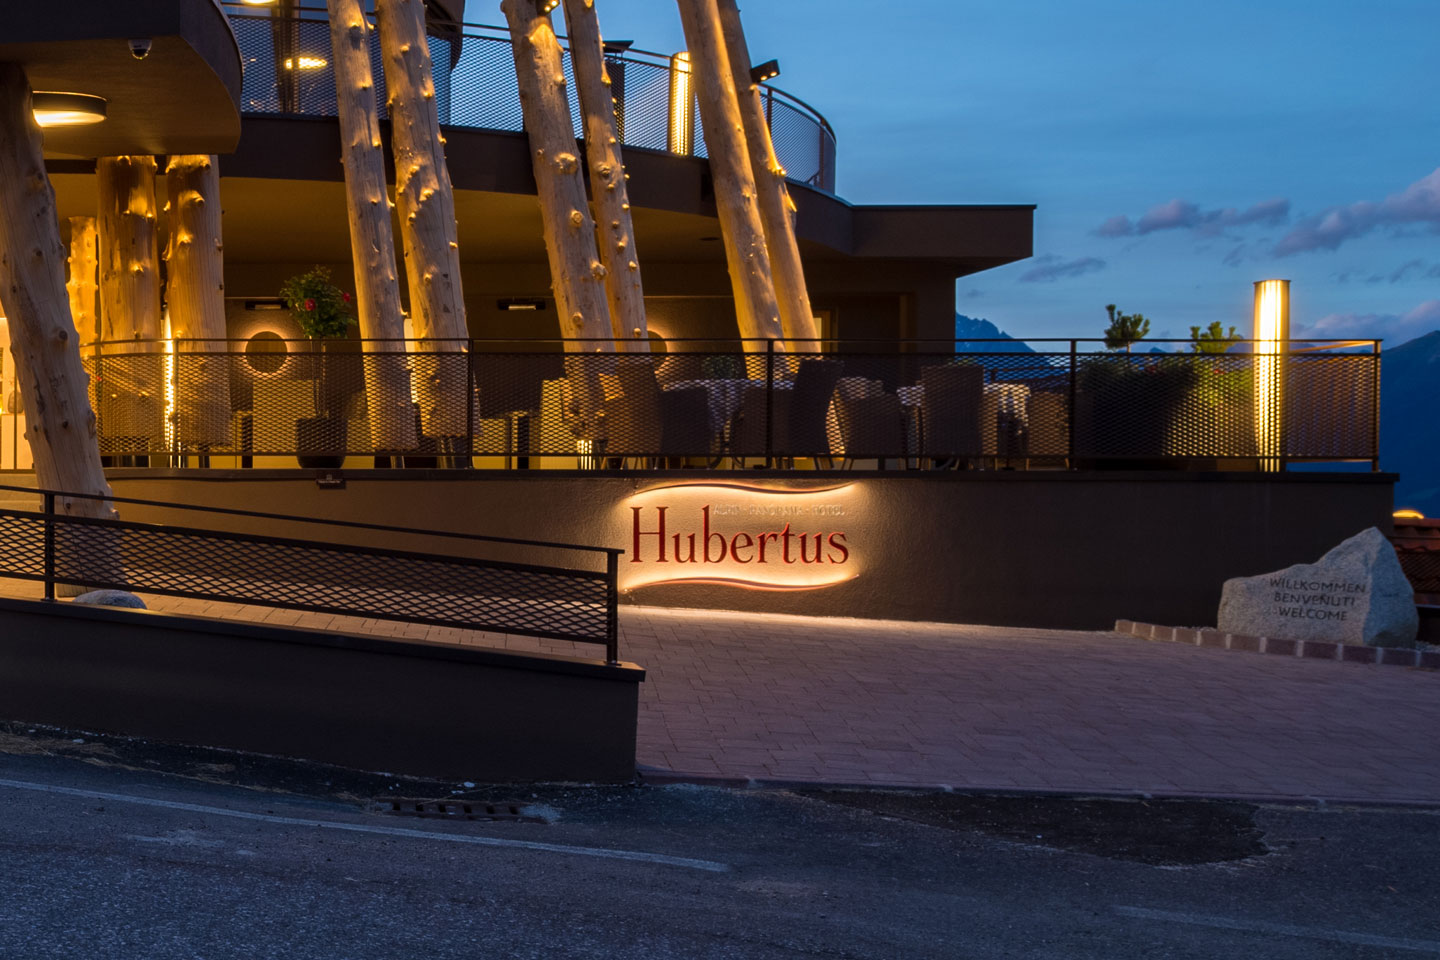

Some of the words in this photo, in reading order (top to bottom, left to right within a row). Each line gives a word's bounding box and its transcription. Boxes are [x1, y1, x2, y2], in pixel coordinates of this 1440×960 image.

[811, 504, 845, 516] HOTEL
[630, 504, 849, 564] Hubertus
[1270, 578, 1366, 593] WILLKOMMEN
[1274, 592, 1355, 606] BENVENUTI
[1278, 606, 1348, 621] WELCOME
